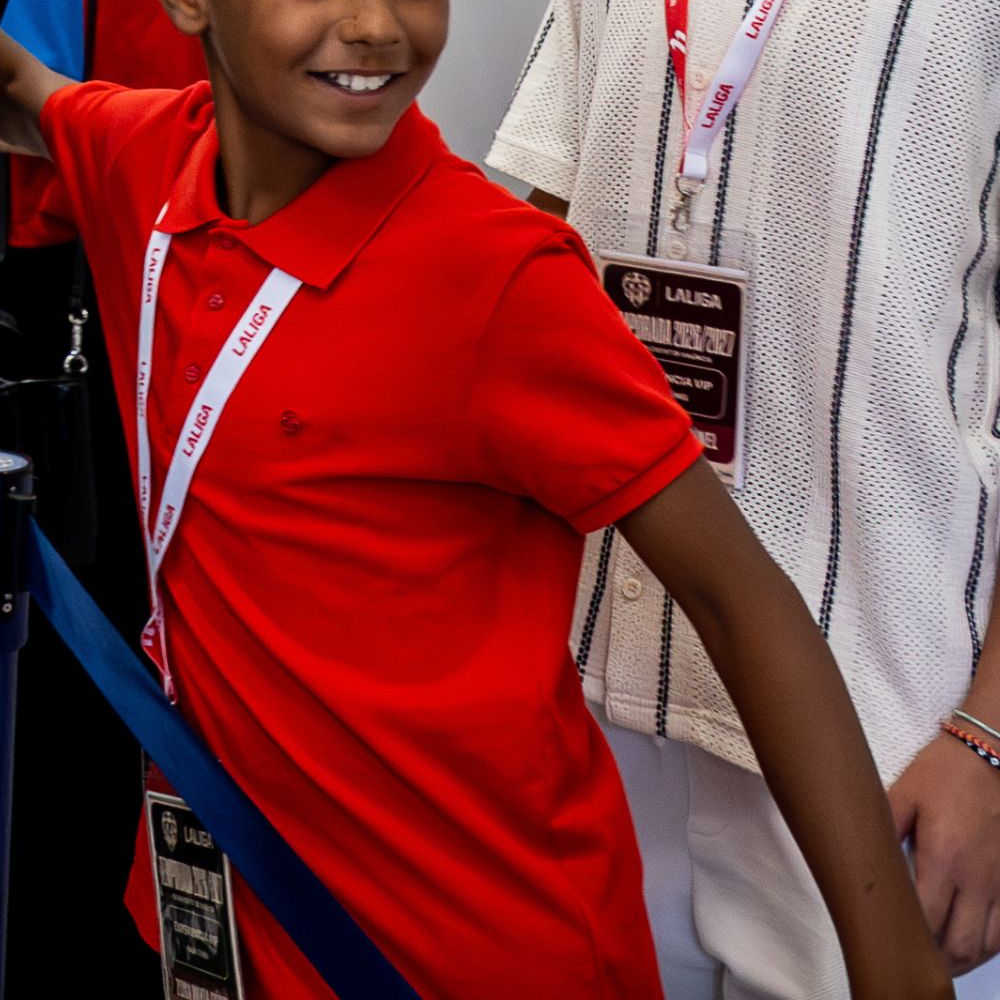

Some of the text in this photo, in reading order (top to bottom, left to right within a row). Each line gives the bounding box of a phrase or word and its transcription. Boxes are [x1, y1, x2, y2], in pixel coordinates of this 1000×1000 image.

[701, 84, 734, 129] LALIGA
[232, 304, 272, 357] LALIGA
[182, 404, 213, 457] LALIGA
